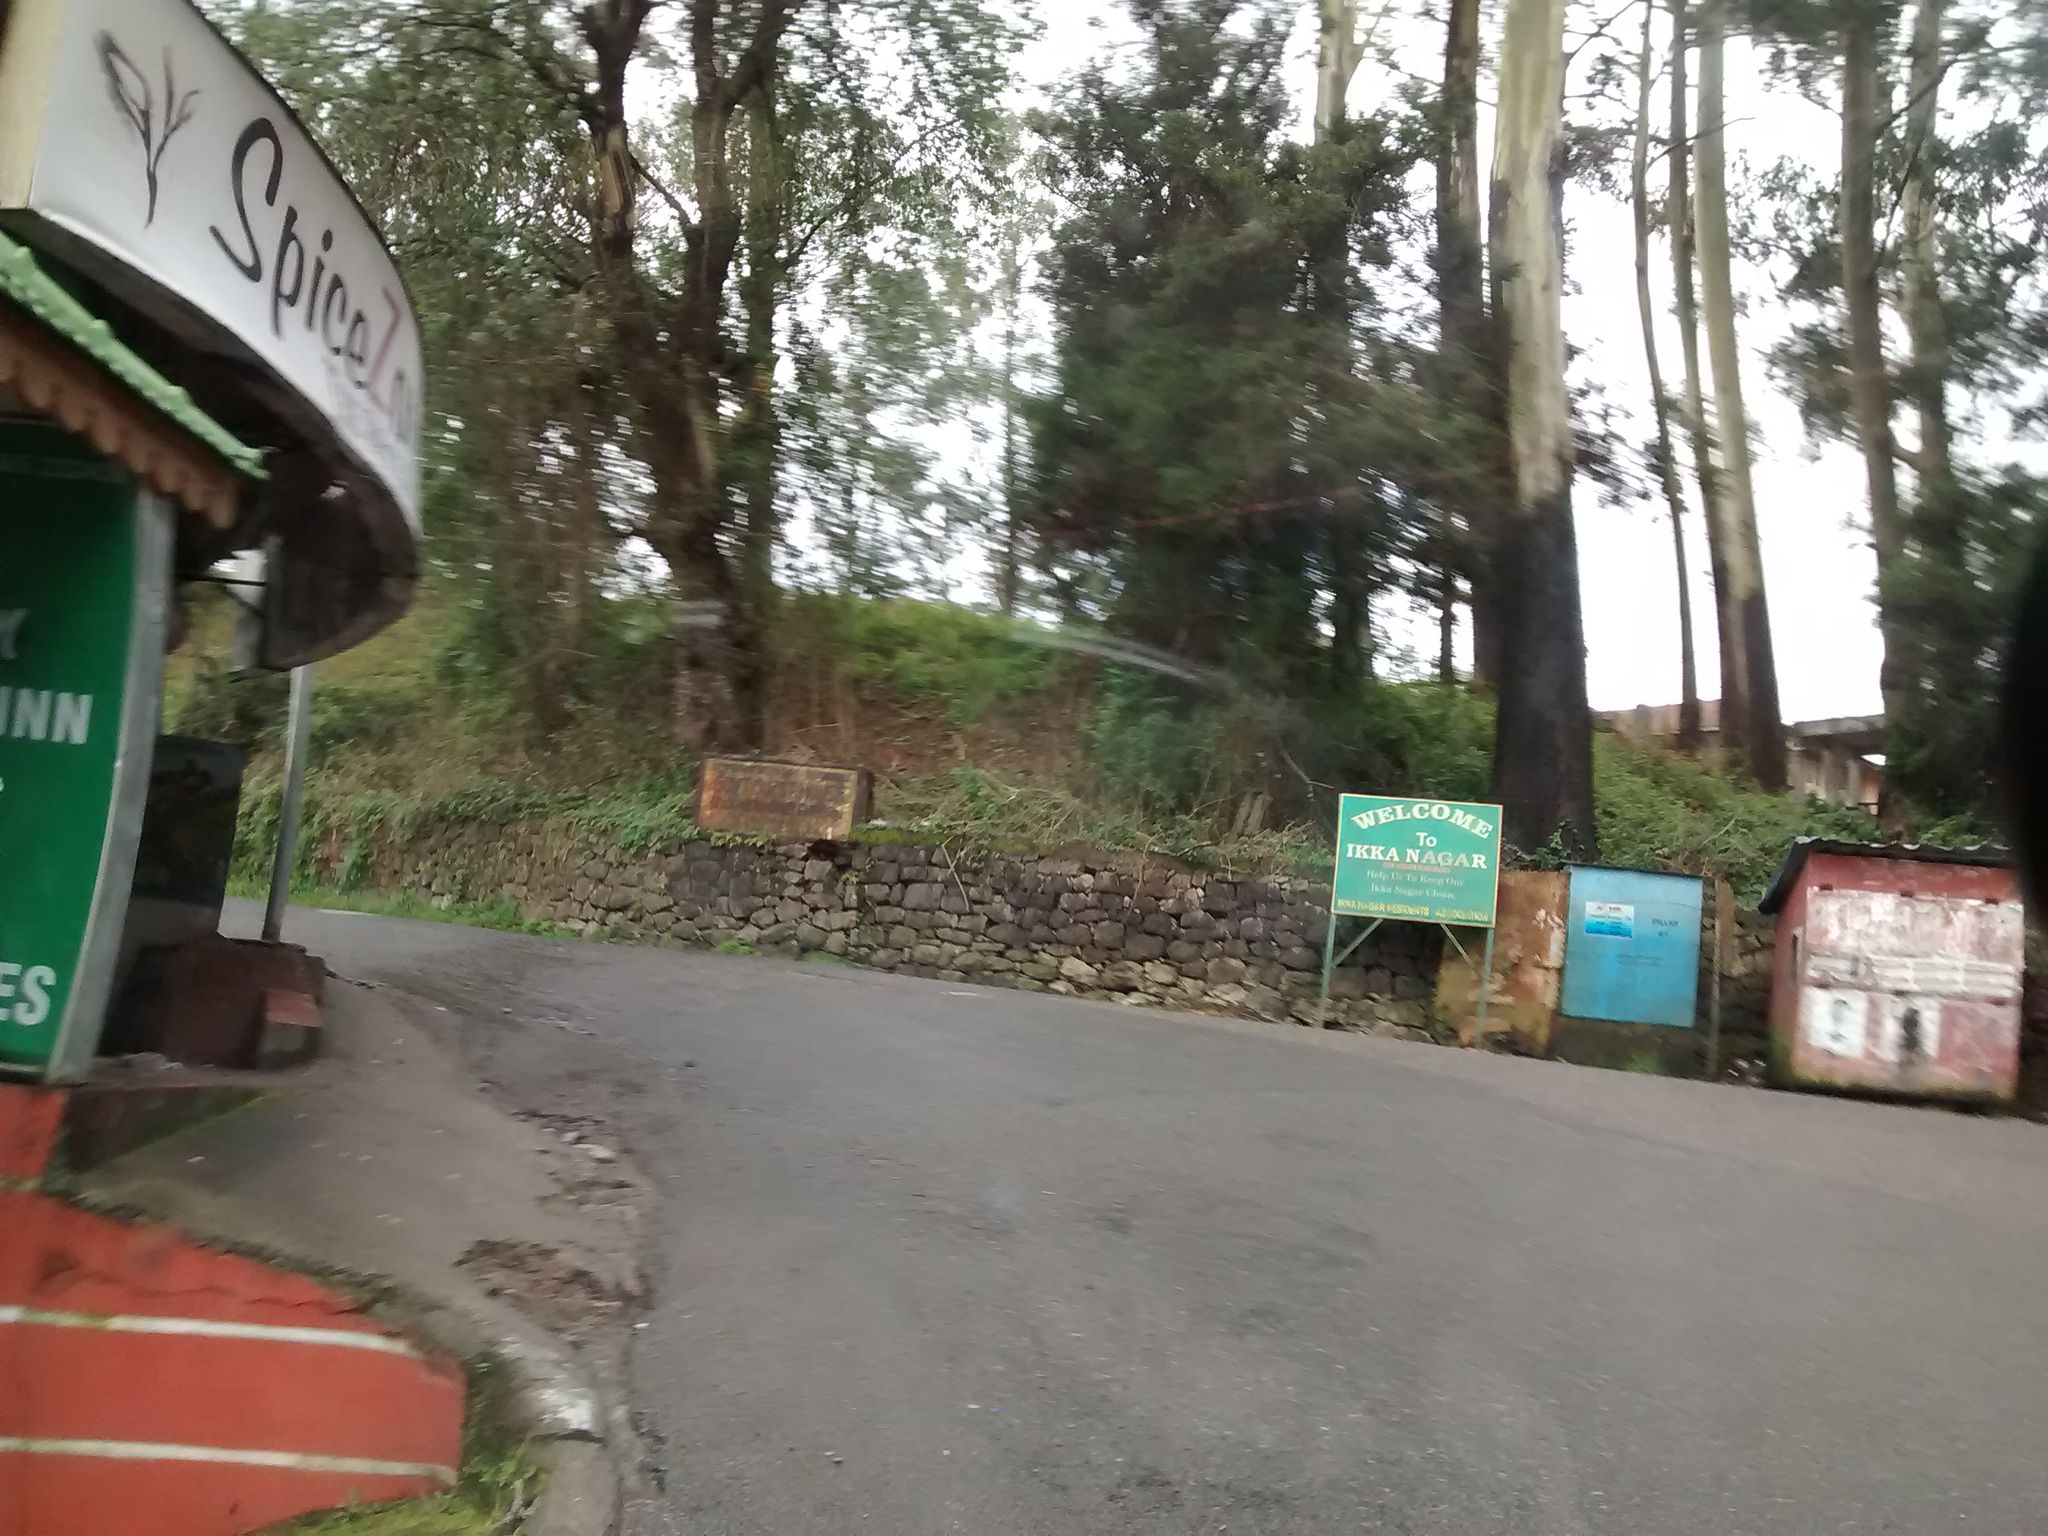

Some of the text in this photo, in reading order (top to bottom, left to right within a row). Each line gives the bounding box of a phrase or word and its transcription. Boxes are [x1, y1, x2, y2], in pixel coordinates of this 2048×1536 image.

[209, 117, 371, 389] Spice
[1351, 803, 1493, 839] WELCOME
[1416, 832, 1437, 847] To
[1346, 843, 1399, 861] IKKA
[1406, 848, 1487, 869] NAGAR
